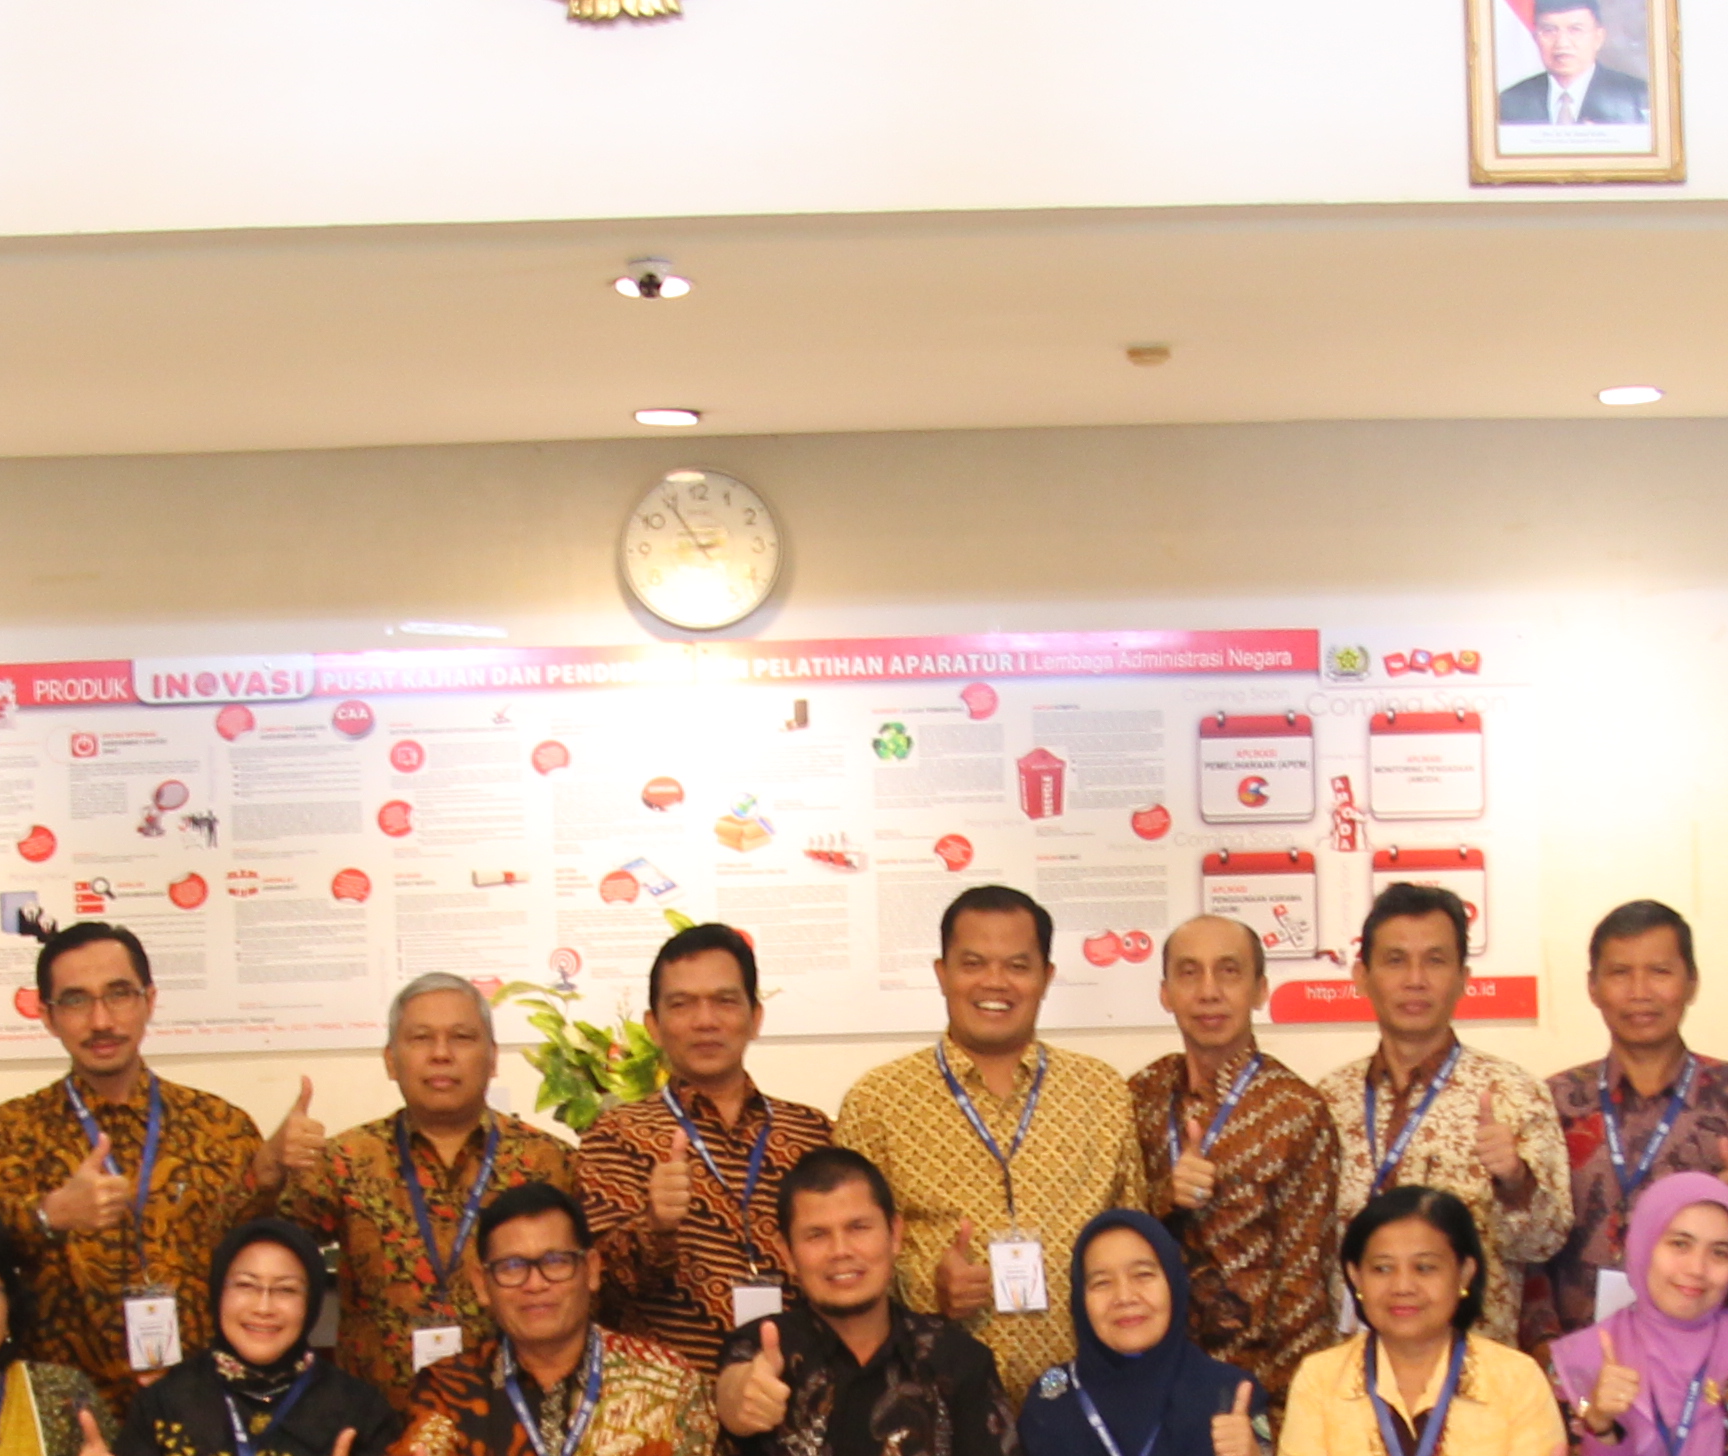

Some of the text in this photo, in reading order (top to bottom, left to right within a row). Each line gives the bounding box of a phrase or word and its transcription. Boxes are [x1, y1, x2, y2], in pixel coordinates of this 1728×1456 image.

[33, 676, 129, 703] PRODUK
[322, 668, 396, 692] PUSAT
[400, 666, 486, 689] KAJIAN
[491, 664, 542, 687] DAN
[753, 655, 884, 678] PELATIHAN
[890, 652, 1013, 675] APARATUR
[1032, 652, 1114, 673] Lembaga
[1119, 649, 1224, 669] Administrasi
[1228, 647, 1293, 670] Negara
[335, 708, 370, 721] CAA
[1305, 691, 1424, 717] Coming
